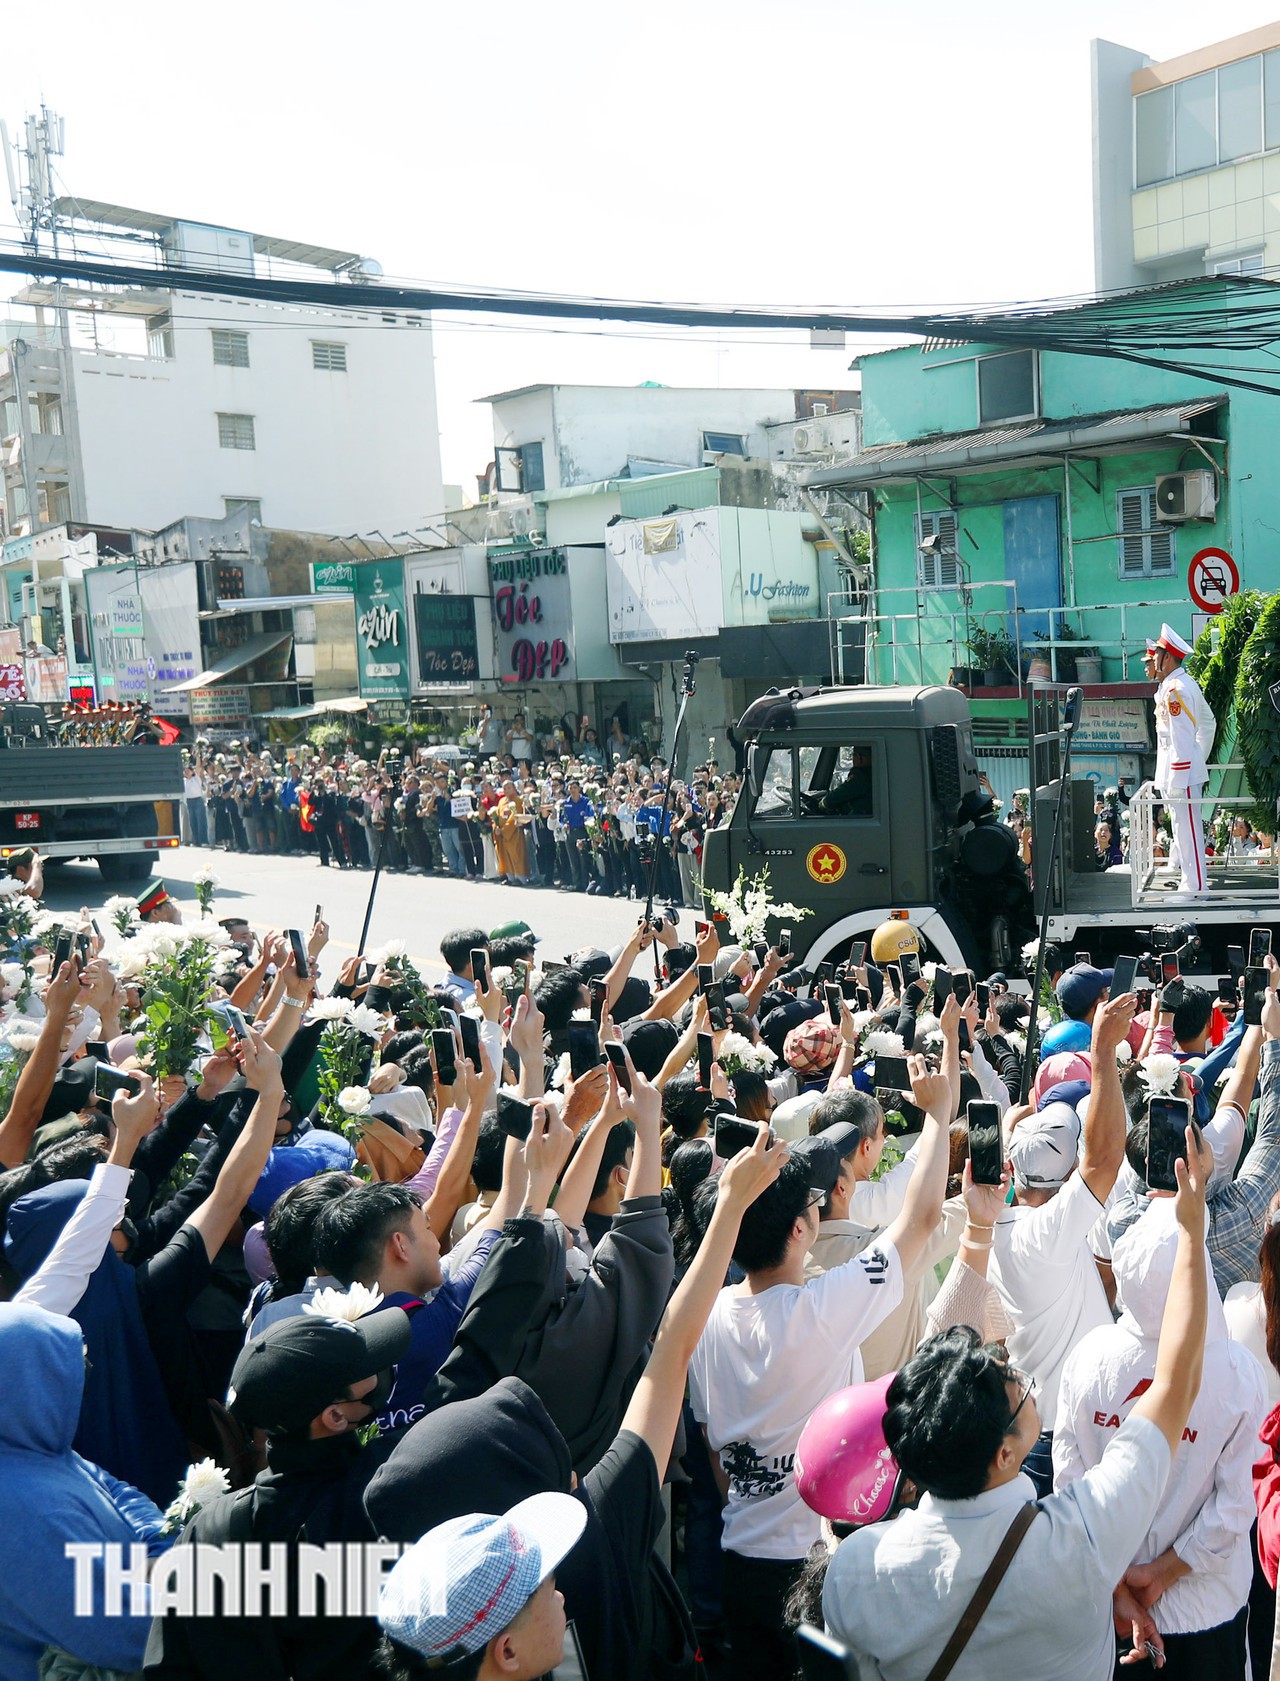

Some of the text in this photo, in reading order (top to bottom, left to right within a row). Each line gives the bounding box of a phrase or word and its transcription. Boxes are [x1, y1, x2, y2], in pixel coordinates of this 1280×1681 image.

[491, 549, 566, 583] PHỤ LIỆU TÓC
[496, 583, 543, 632] Tóc
[761, 579, 810, 600] fashion
[425, 649, 476, 675] Tóc Đẹp
[511, 638, 569, 682] Đẹp
[853, 1466, 890, 1516] Choose
